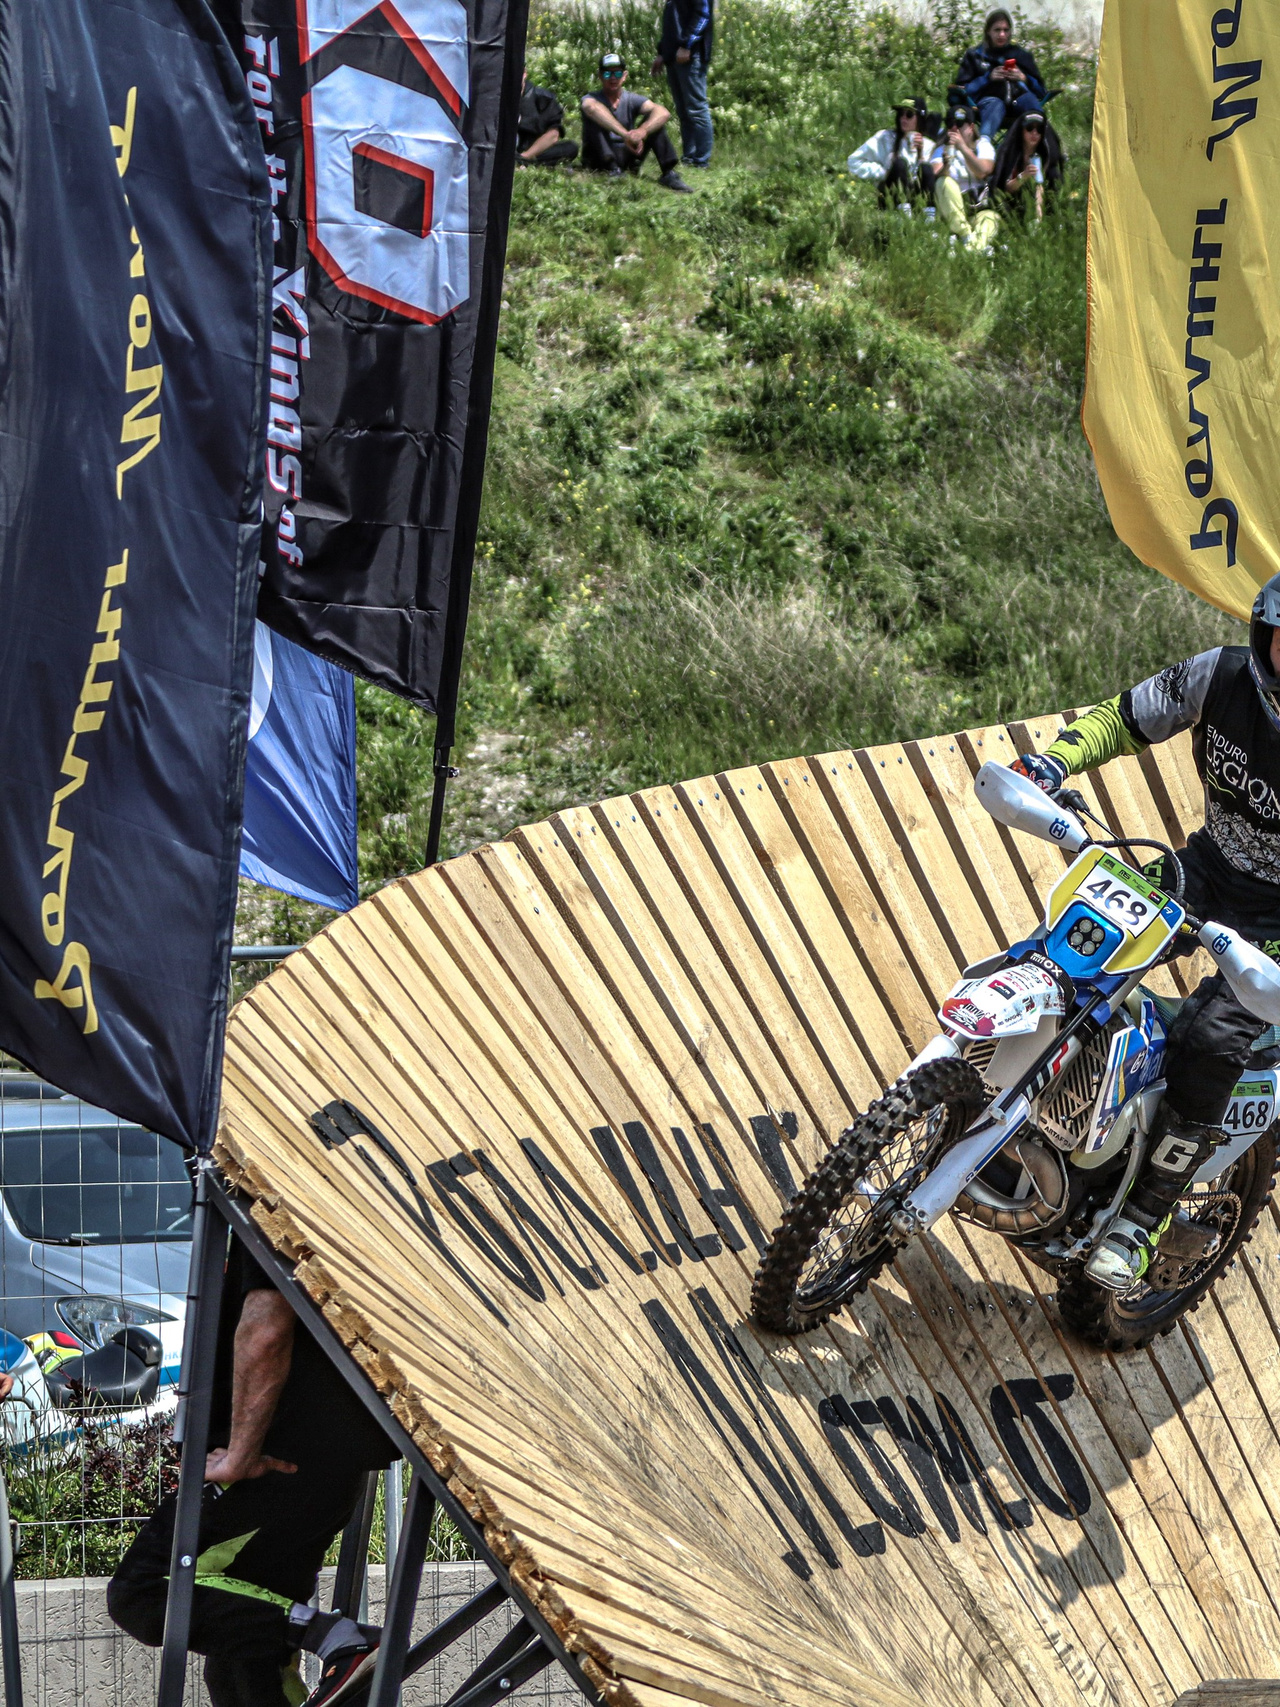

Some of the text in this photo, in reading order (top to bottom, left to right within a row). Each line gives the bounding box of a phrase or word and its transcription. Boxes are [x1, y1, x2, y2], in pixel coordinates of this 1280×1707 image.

[243, 33, 281, 137] For
[277, 503, 304, 568] of
[1206, 724, 1248, 766] ENDURO
[1086, 879, 1148, 926] 468
[1223, 1101, 1269, 1130] 468
[1044, 1126, 1073, 1150] ARTAFON
